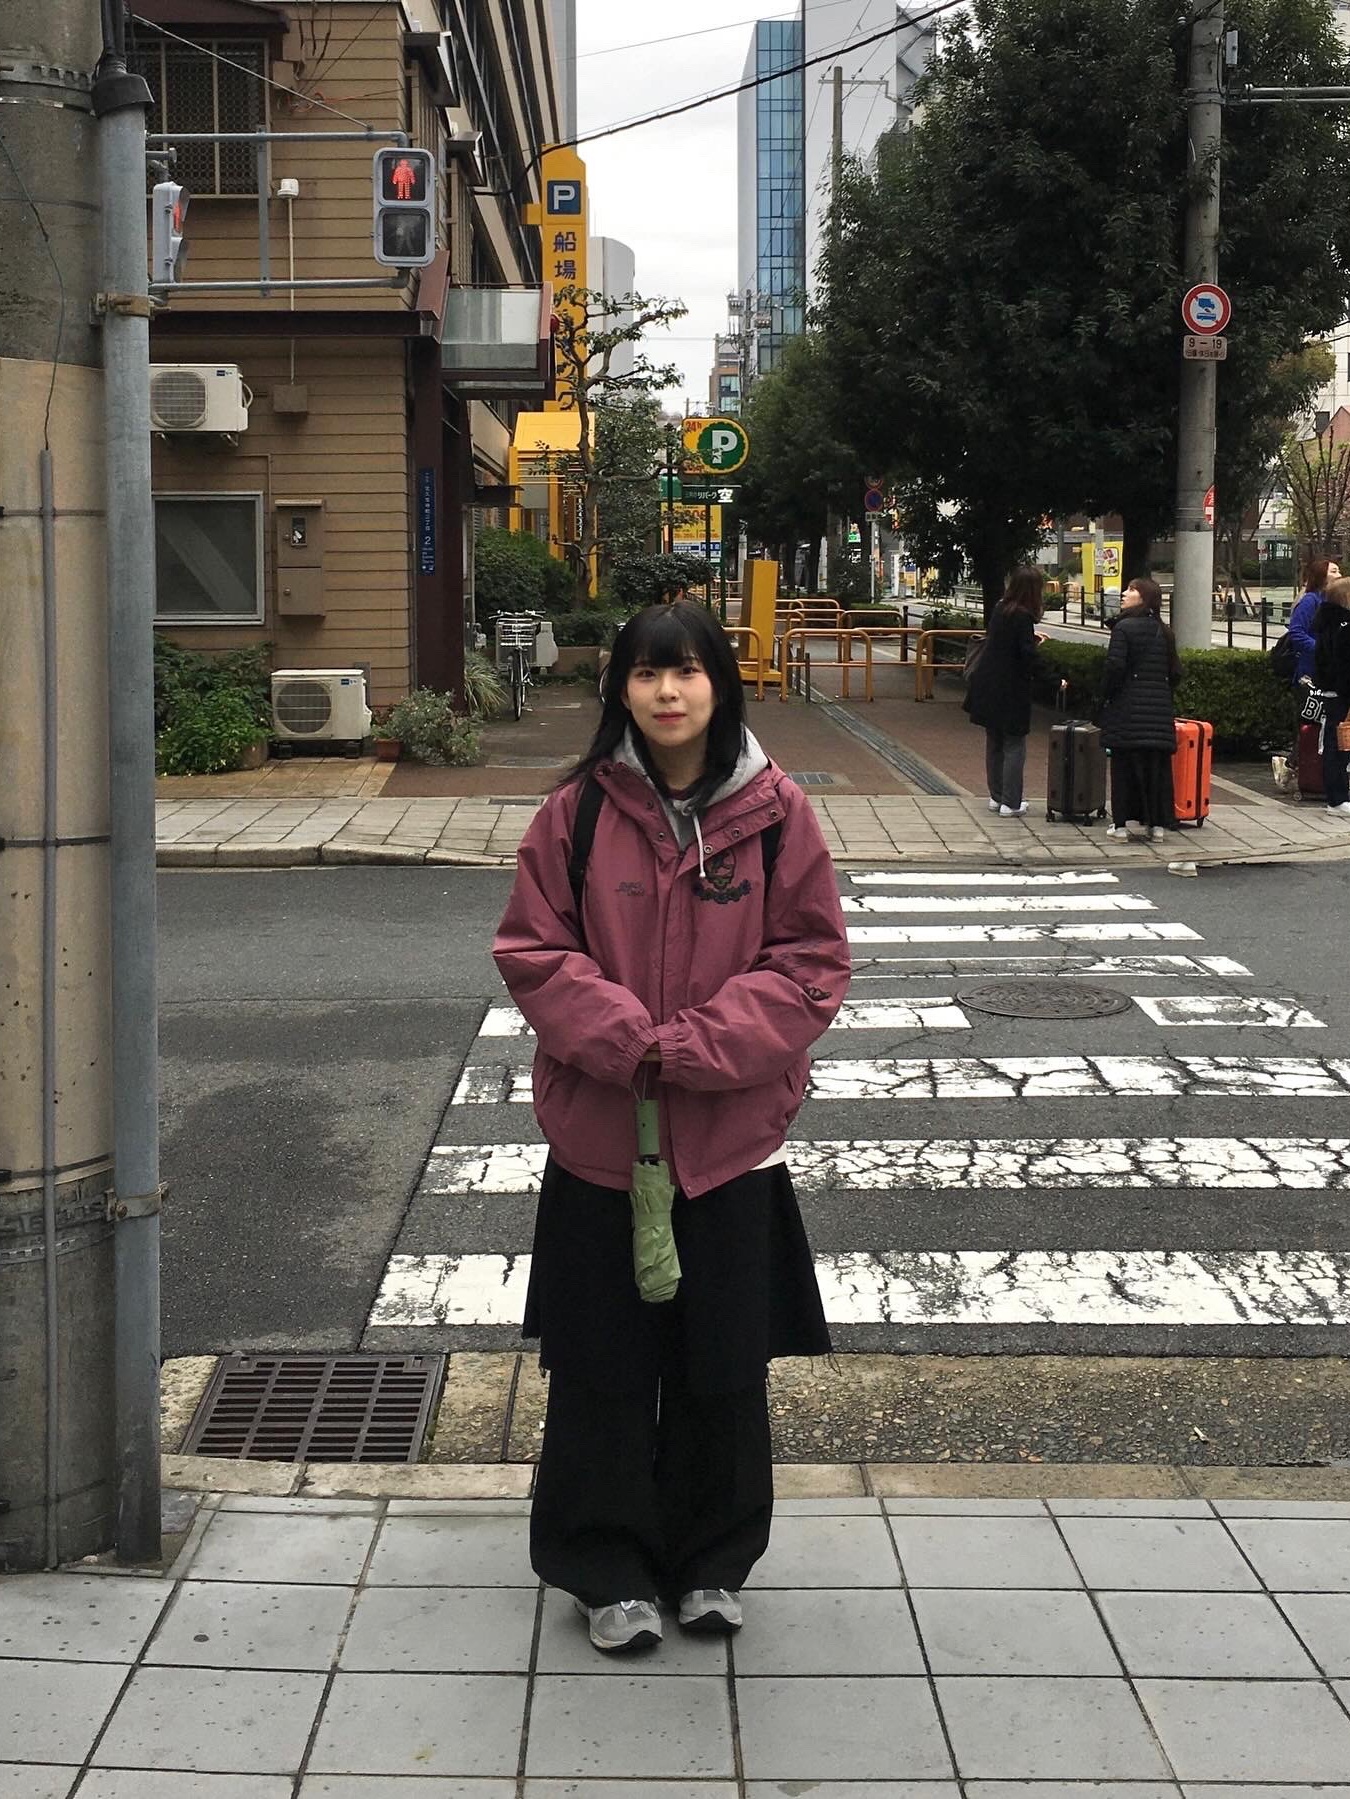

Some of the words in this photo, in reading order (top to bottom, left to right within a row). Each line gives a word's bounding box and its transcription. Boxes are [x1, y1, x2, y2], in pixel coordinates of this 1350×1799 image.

[553, 184, 576, 211] P
[711, 430, 738, 464] P
[717, 488, 734, 505] 空
